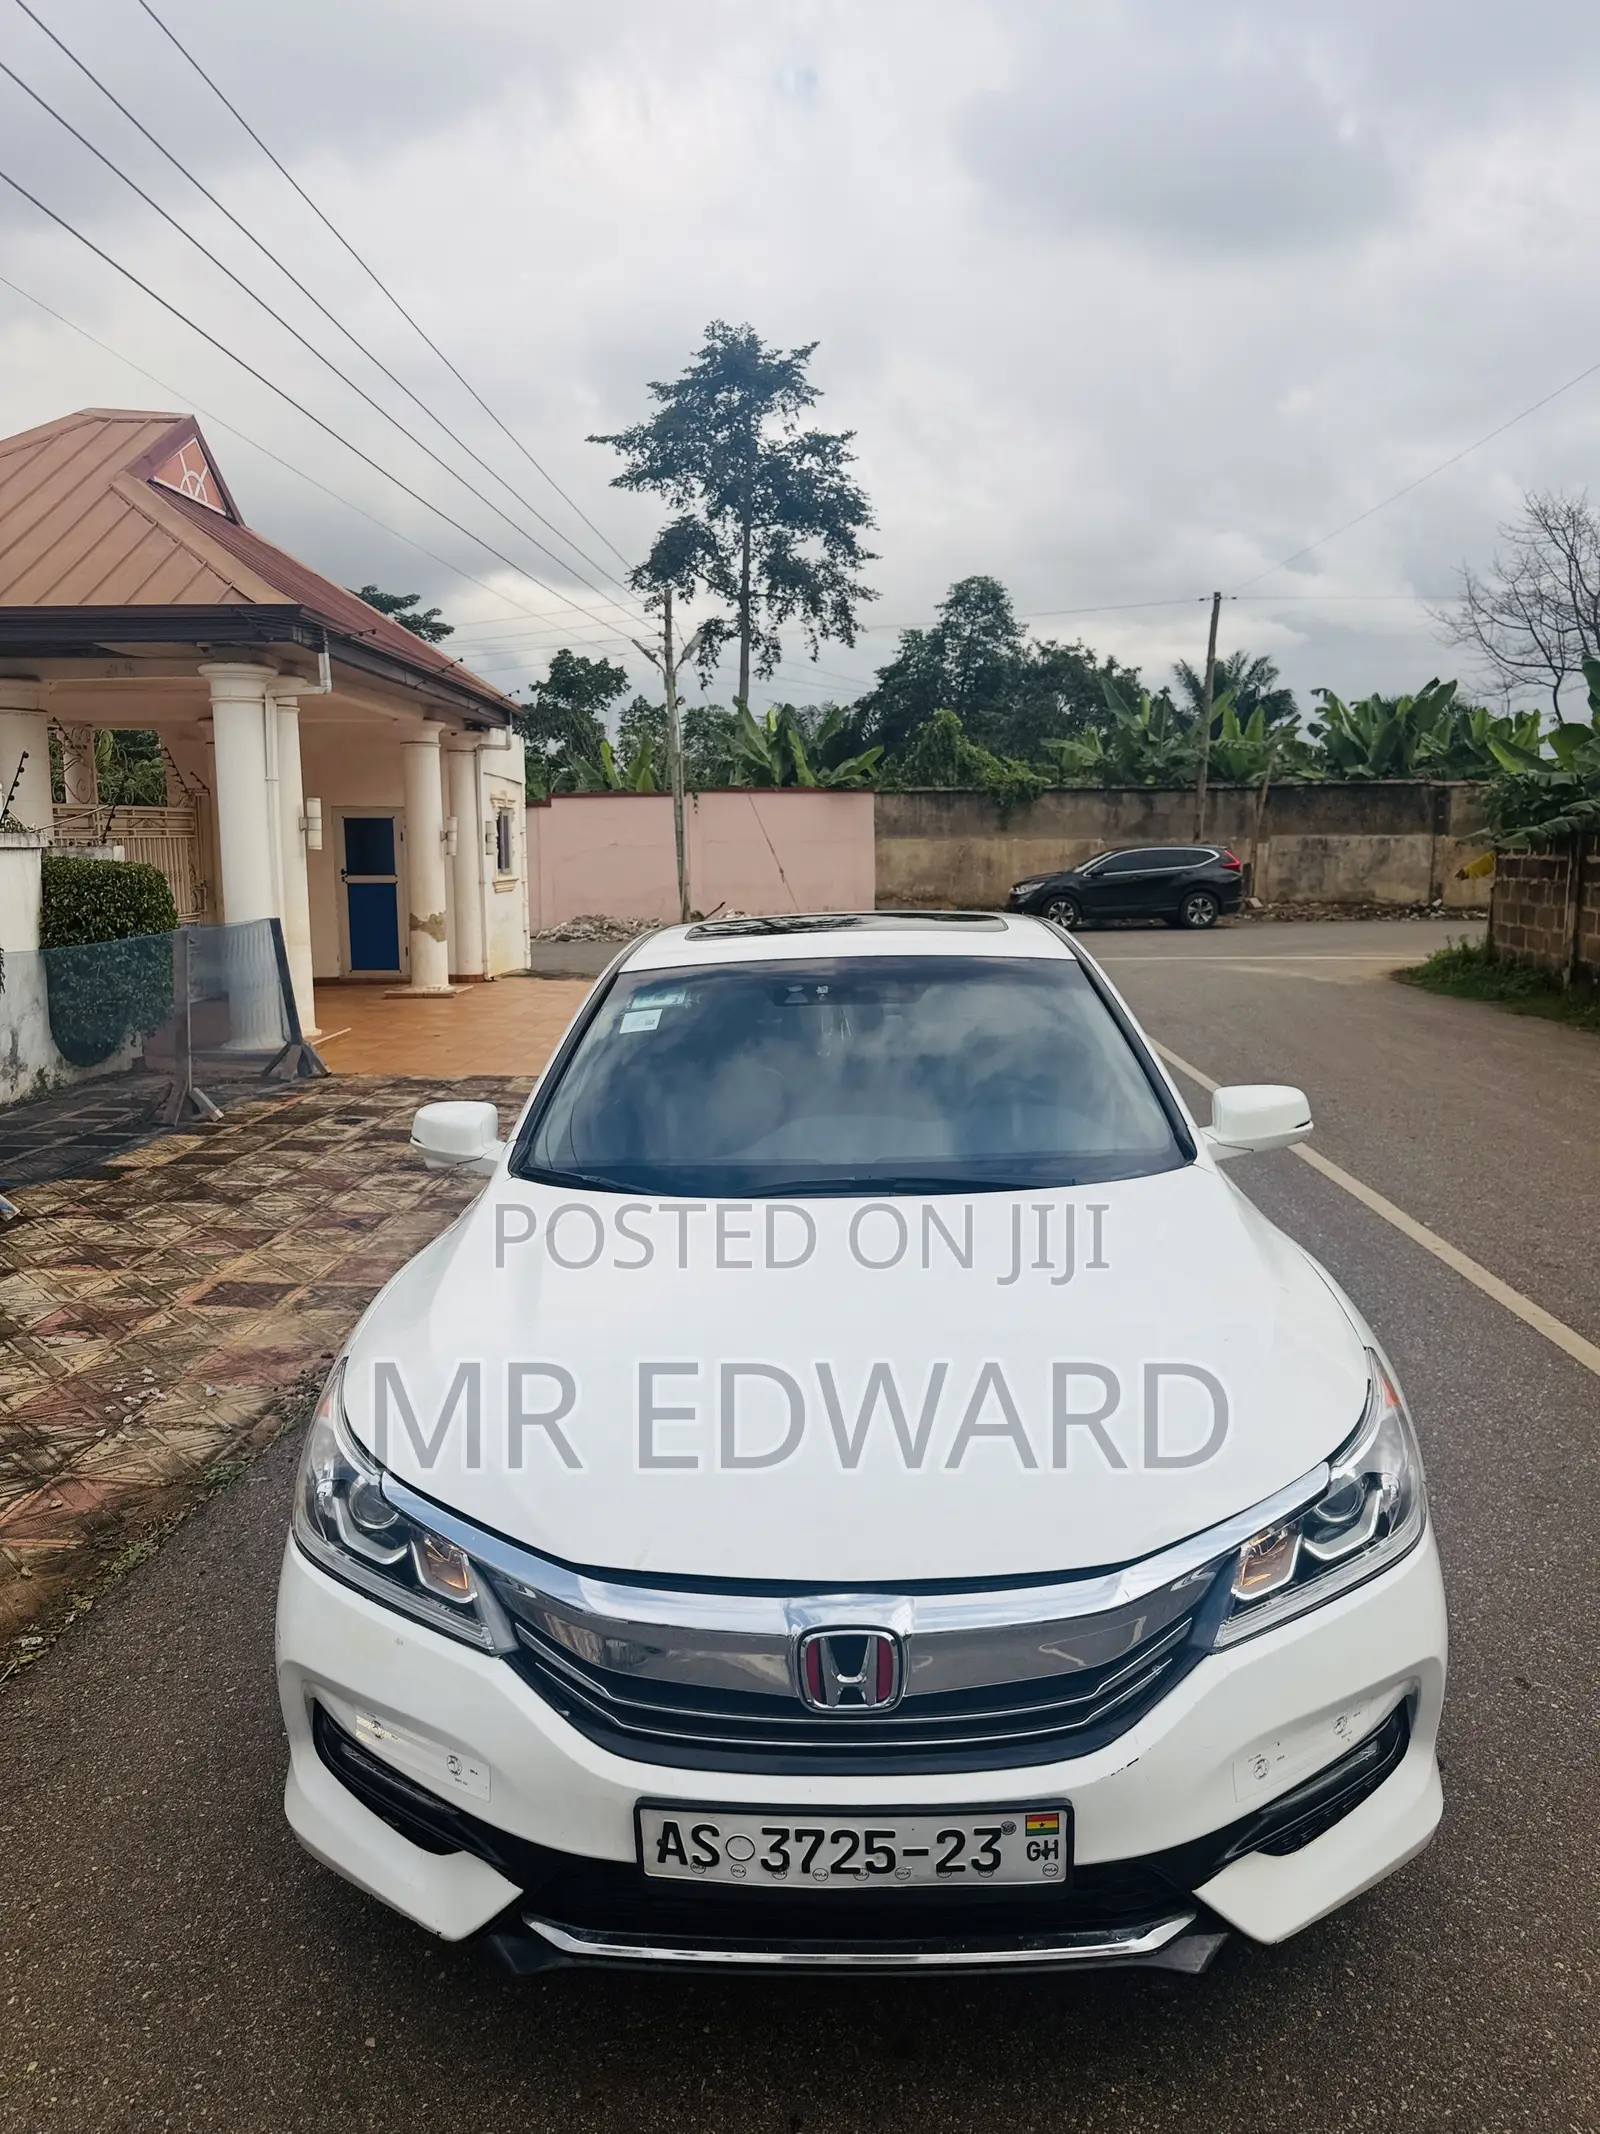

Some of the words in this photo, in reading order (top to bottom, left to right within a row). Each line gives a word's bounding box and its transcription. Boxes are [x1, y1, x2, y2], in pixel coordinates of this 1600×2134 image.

[657, 1821, 720, 1867] AS
[760, 1827, 1002, 1874] 3725-23
[1027, 1839, 1058, 1861] GH
